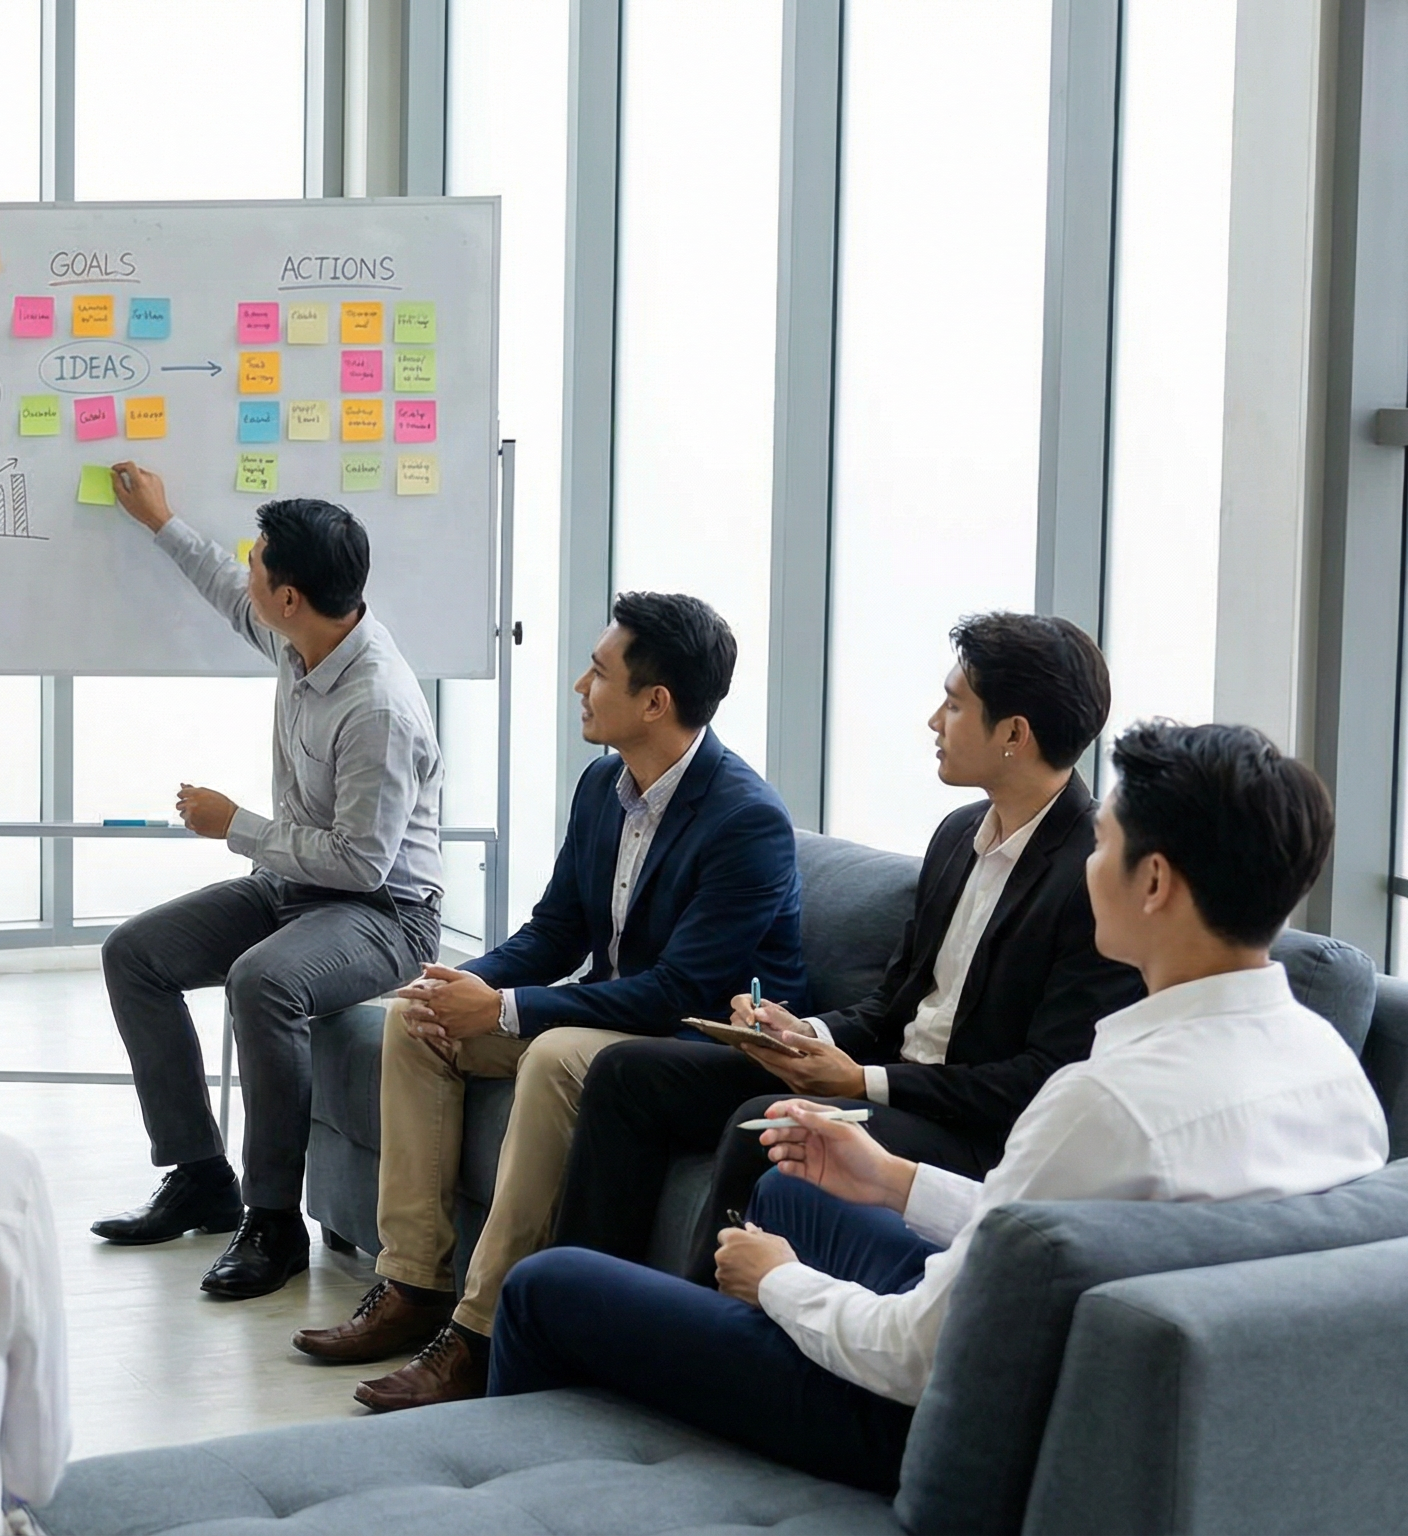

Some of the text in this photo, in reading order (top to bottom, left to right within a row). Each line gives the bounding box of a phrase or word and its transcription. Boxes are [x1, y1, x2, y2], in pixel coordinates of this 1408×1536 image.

[50, 251, 136, 277] GOALS
[281, 256, 395, 281] ACTIONS
[55, 355, 135, 380] IDEAS
